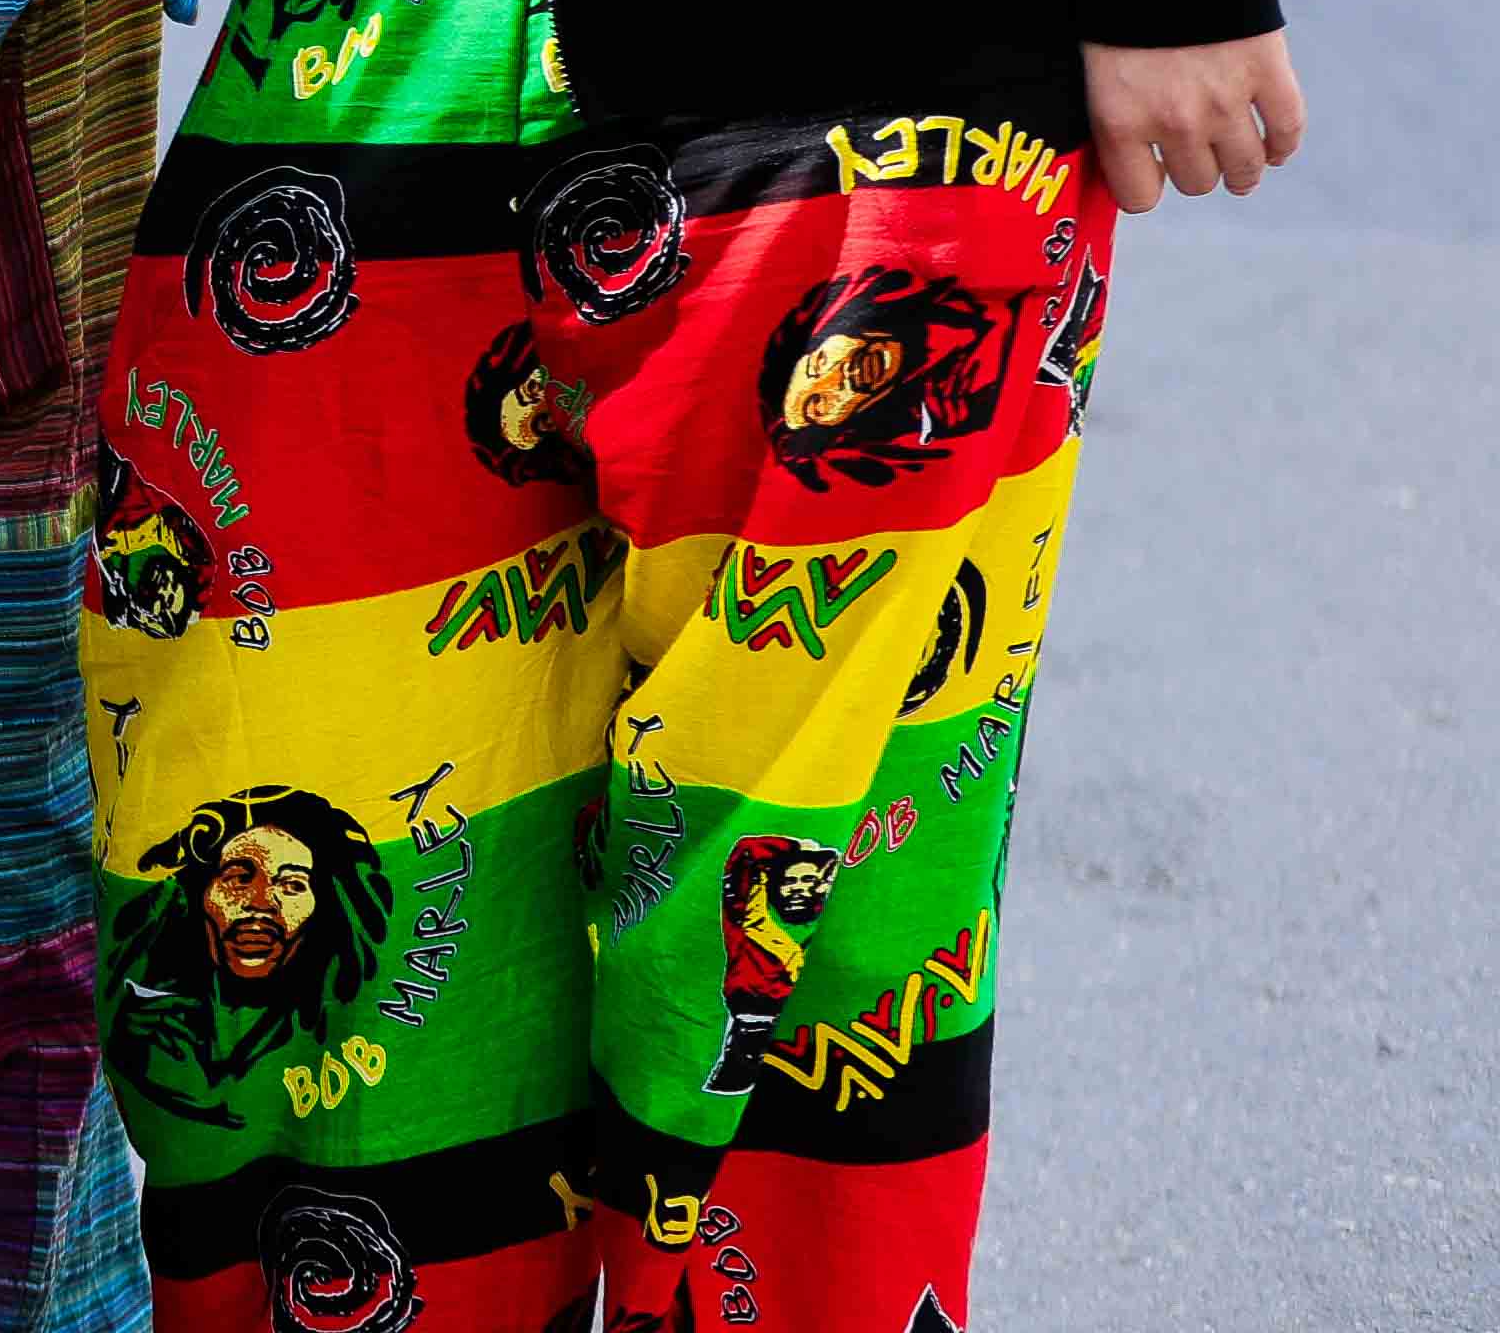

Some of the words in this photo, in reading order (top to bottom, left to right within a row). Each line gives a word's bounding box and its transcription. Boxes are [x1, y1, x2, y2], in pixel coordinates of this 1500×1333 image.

[825, 116, 1071, 216] MARLEY
[124, 366, 251, 530] MARLEY
[227, 545, 277, 652] BOB
[843, 796, 919, 869] OB
[282, 1034, 387, 1119] BOB
[376, 760, 474, 1030] MARLEY
[699, 1205, 759, 1326] BOB
